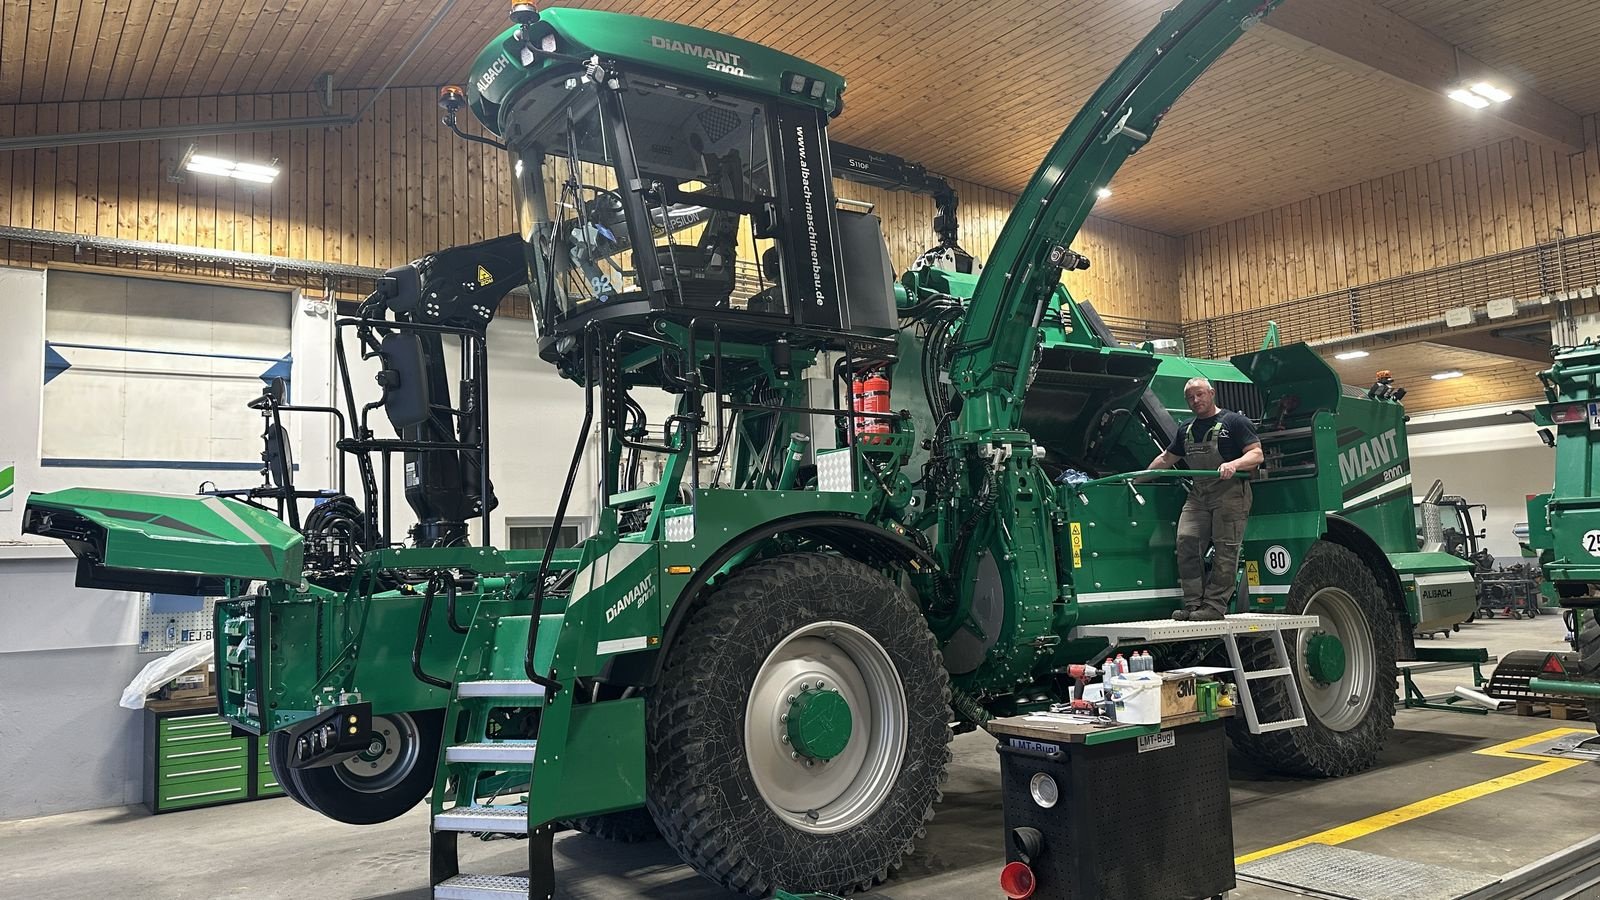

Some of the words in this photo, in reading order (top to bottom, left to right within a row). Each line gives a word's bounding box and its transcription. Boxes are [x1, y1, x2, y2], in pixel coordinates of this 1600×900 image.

[476, 53, 509, 94] ALBACH
[706, 60, 744, 77] 2000
[669, 212, 701, 231] PSILON
[796, 126, 825, 306] www.albach-maschinenbau.de
[1338, 427, 1398, 486] MANT
[1383, 464, 1404, 482] 2000
[1269, 551, 1286, 569] 80
[637, 584, 657, 609] 2000
[1422, 588, 1453, 599] ALBACH
[1177, 679, 1195, 698] 3M
